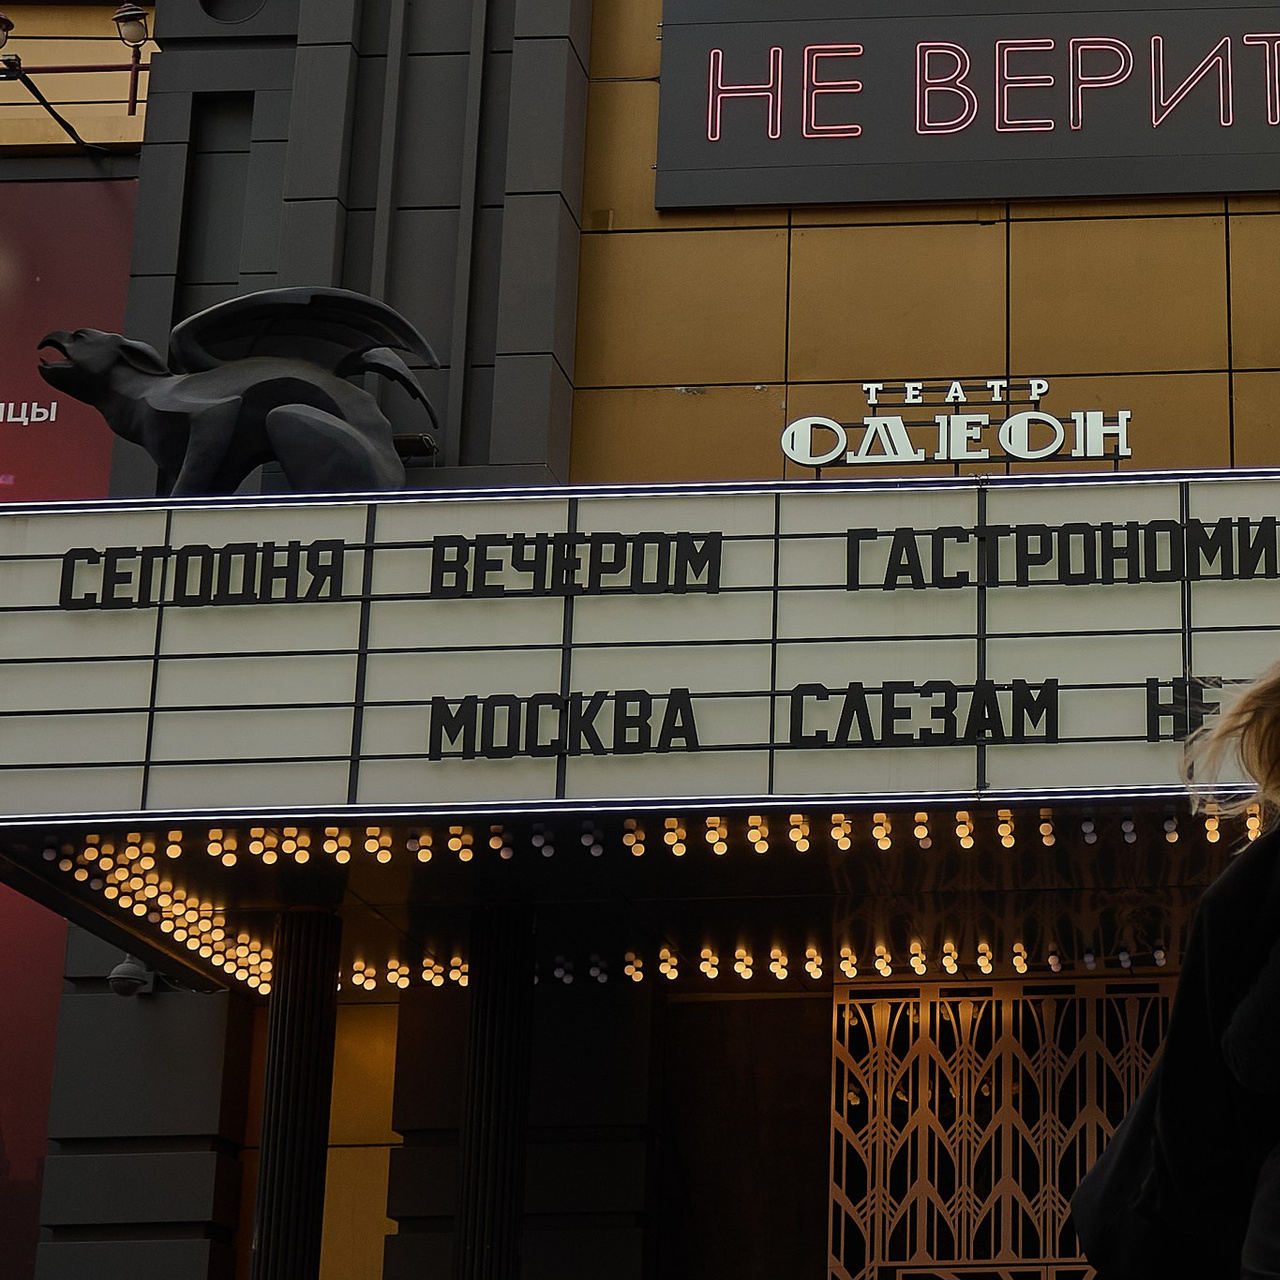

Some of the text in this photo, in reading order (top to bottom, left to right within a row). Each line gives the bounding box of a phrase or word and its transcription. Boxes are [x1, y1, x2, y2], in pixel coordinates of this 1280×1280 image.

[707, 43, 864, 141] НЕ
[862, 379, 1050, 405] ТЕАТР
[780, 409, 1132, 466] ОДЕОН
[58, 538, 346, 612] СЕГОДНЯ
[430, 531, 723, 599] ВЕЧЕРОМ
[428, 687, 701, 761] МОСКВА
[790, 677, 1060, 749] СЛЕЗАМ
